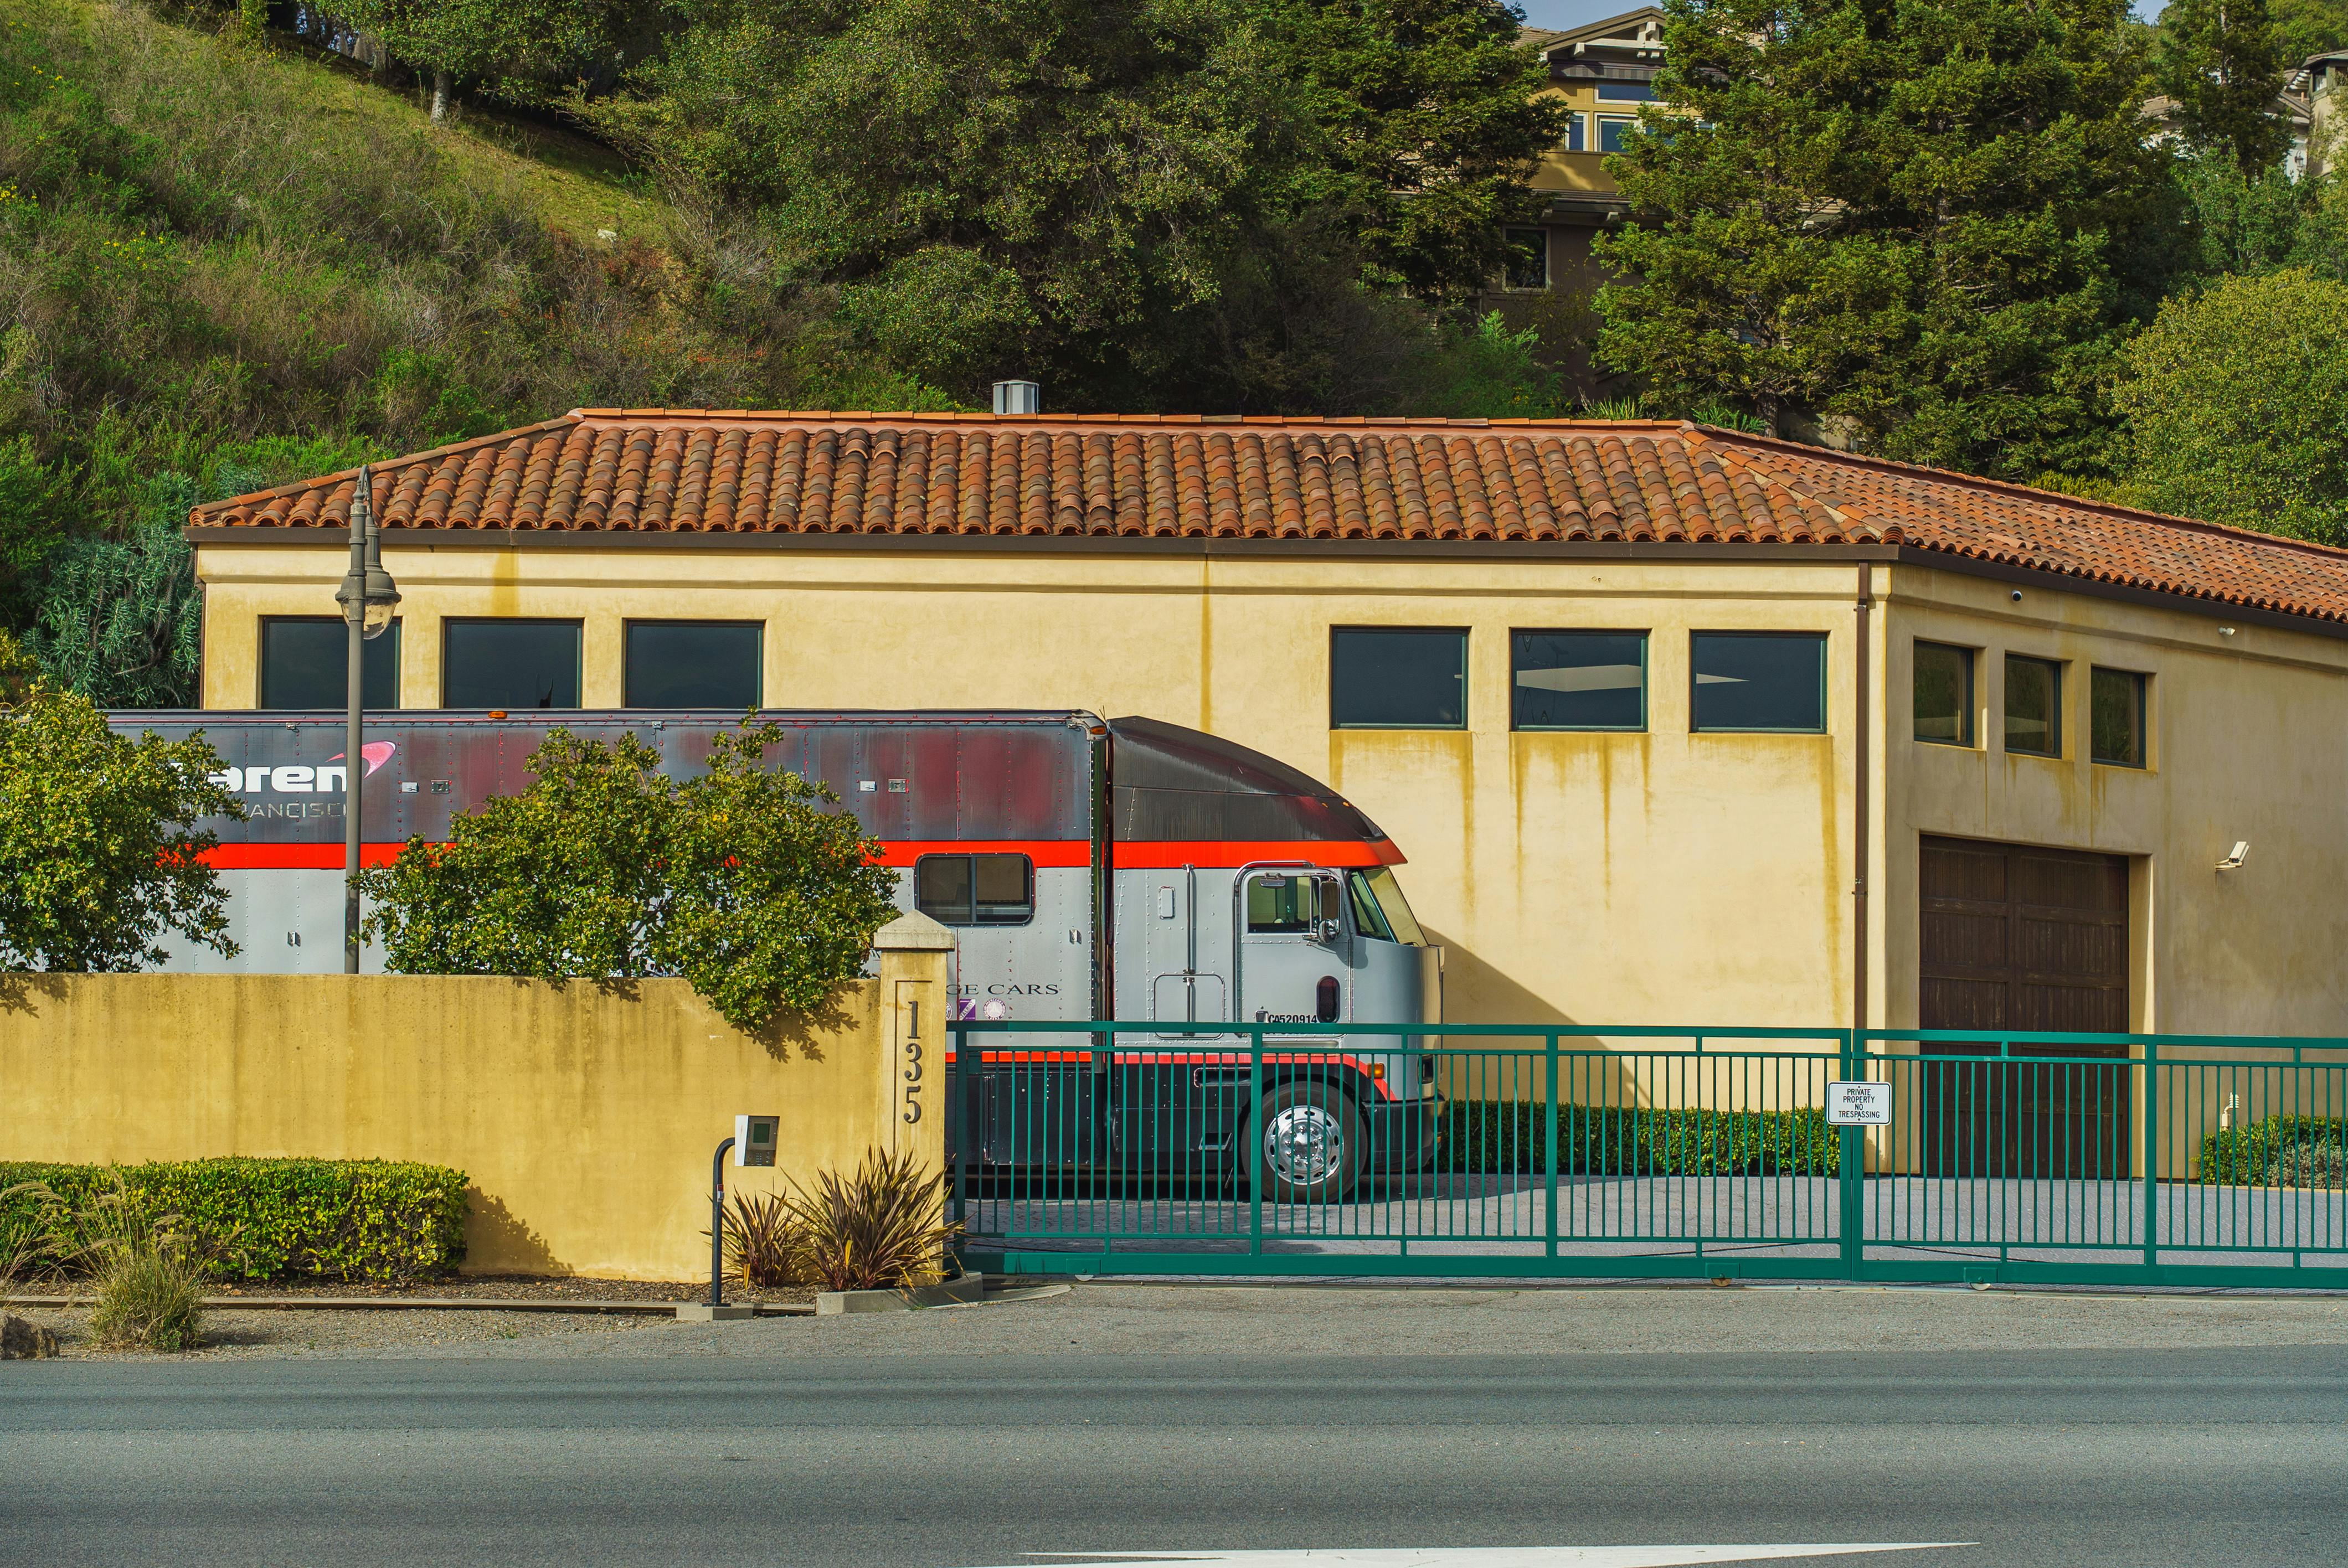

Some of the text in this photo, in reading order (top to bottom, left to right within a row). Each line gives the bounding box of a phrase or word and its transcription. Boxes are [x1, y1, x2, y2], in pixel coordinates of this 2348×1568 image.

[987, 984, 1059, 995] CARS
[1268, 1014, 1317, 1024] CA520914
[903, 1001, 923, 1124] 135
[1839, 1110, 1880, 1118] TRESPASSING
